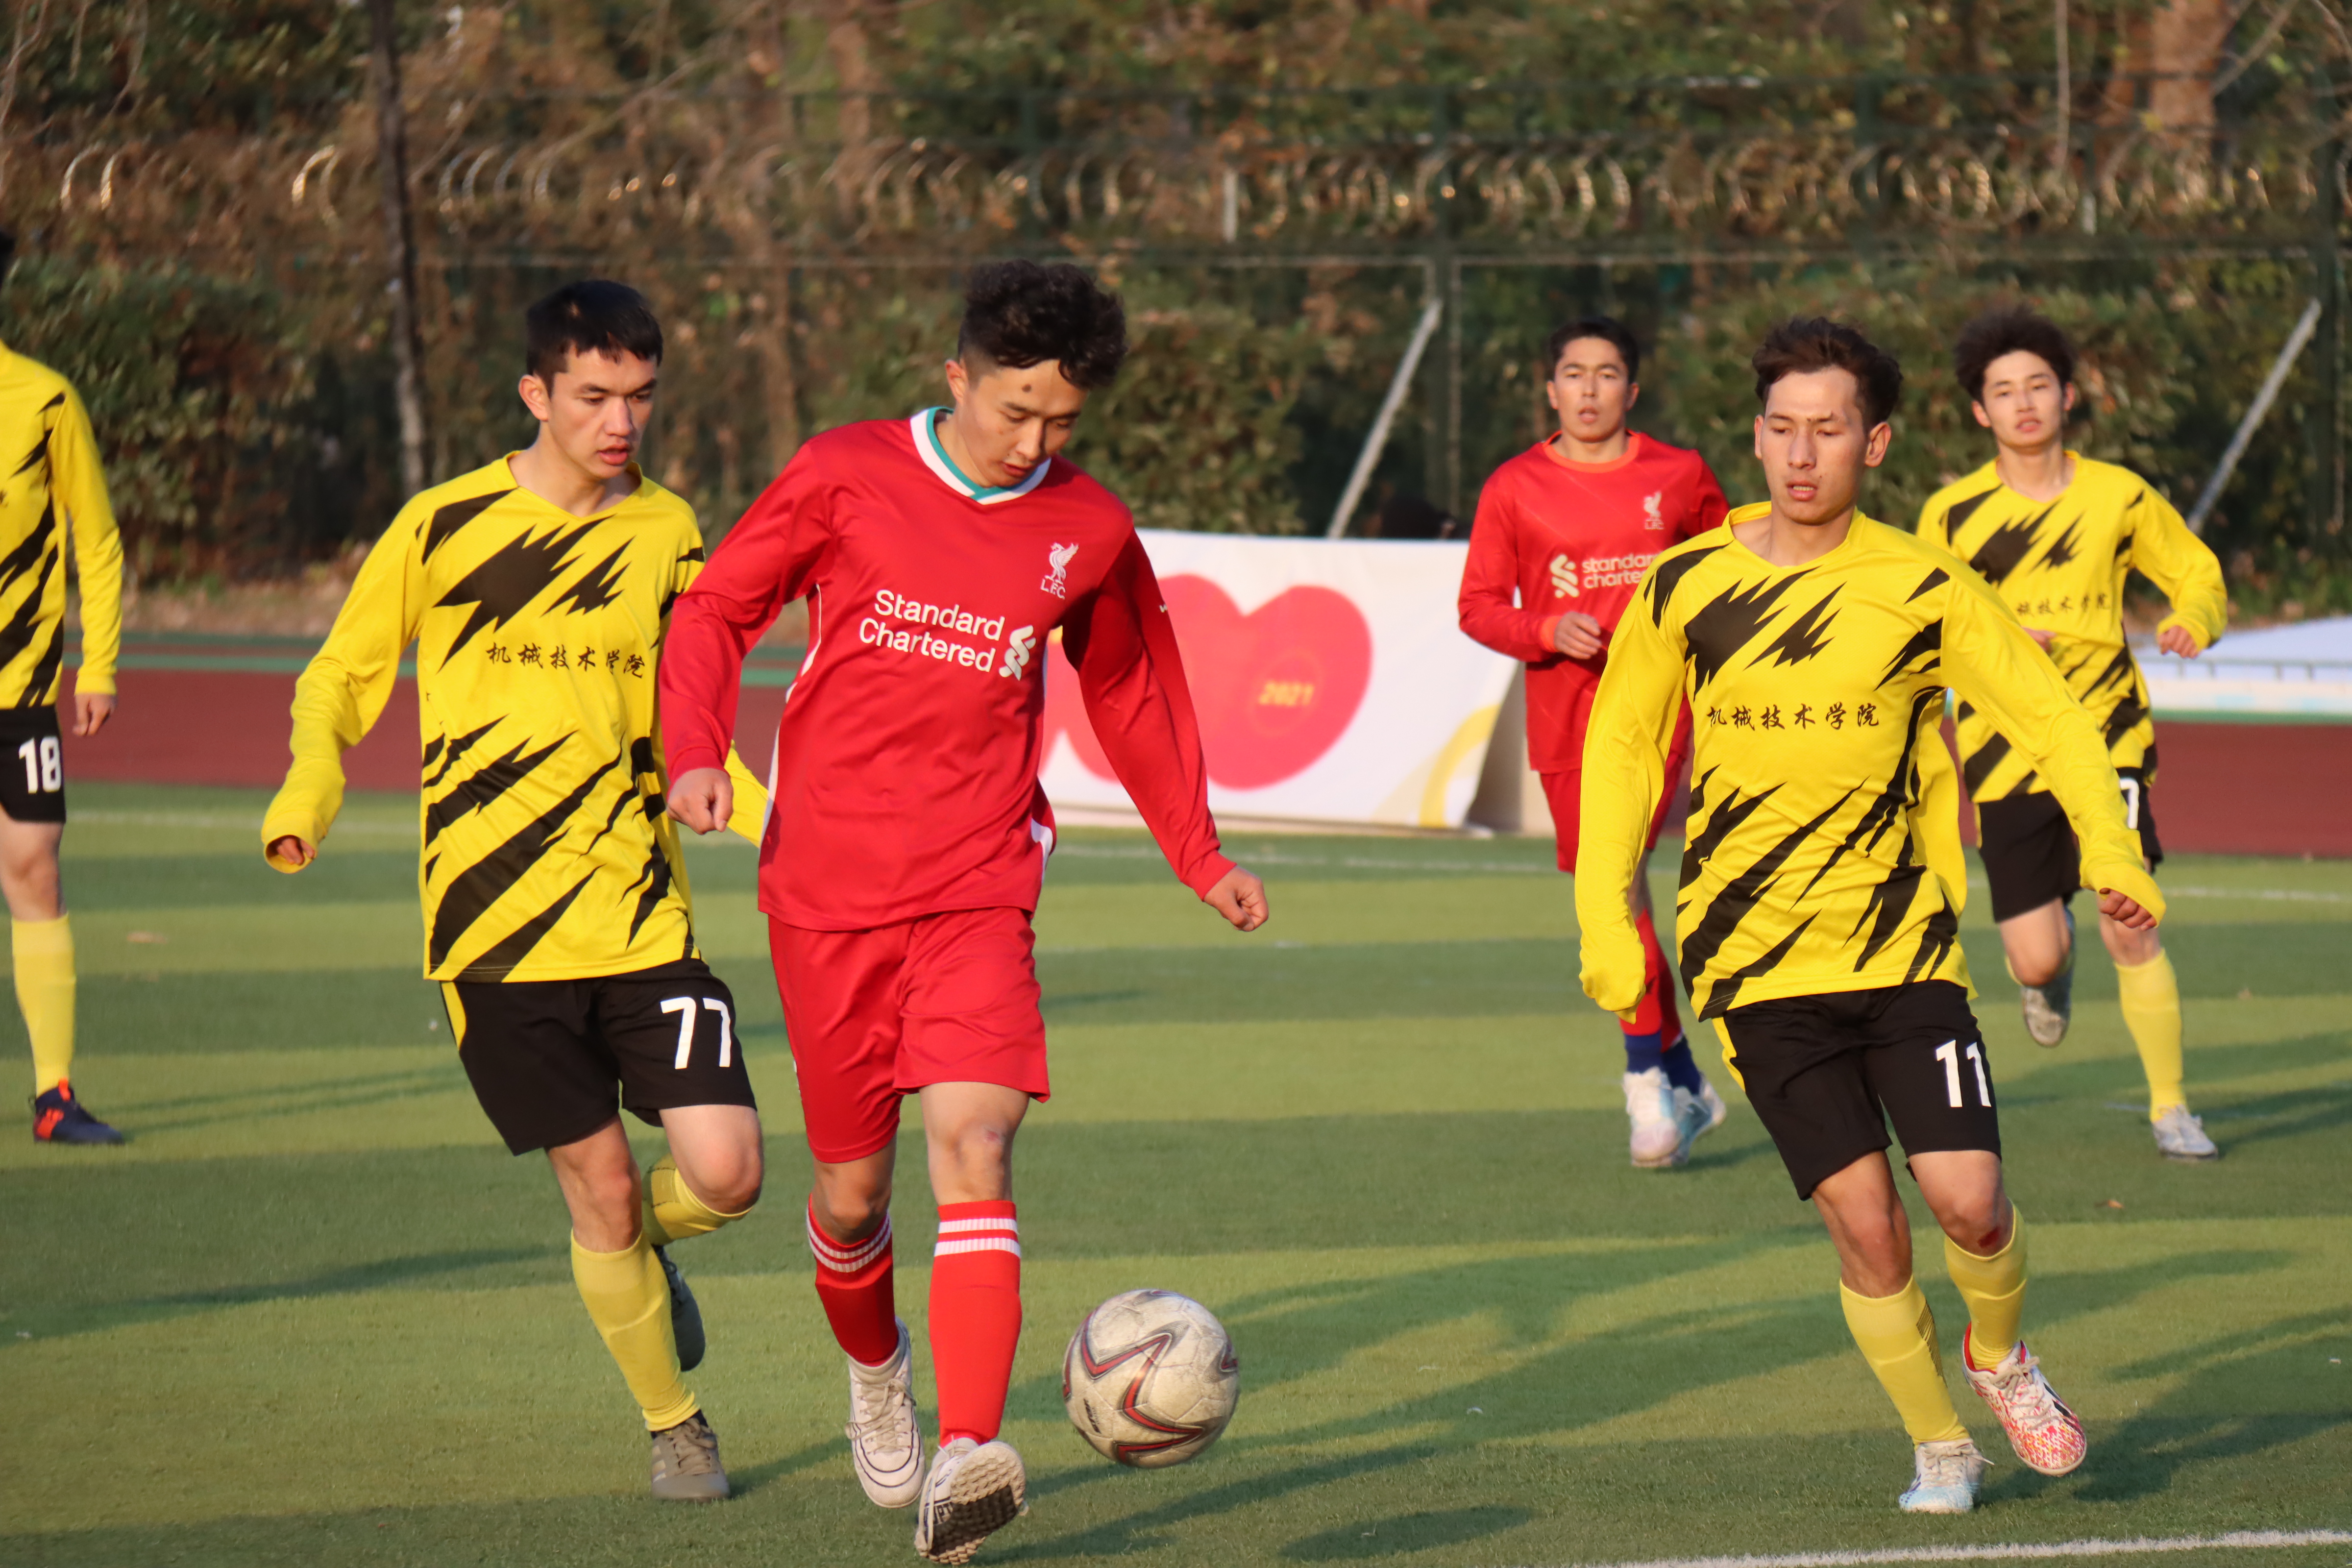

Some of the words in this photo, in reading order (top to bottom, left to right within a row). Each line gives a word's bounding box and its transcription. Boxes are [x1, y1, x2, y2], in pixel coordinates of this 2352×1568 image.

[1582, 552, 1663, 573] standar
[1584, 569, 1646, 589] charte
[1040, 578, 1066, 600] LFC
[874, 589, 1006, 641] Standard
[486, 641, 646, 679] 机械技术学院
[858, 617, 997, 673] Chartered
[1257, 681, 1315, 707] 2021
[1707, 701, 1880, 731] 机械技术学院
[18, 735, 62, 794] 18
[660, 996, 732, 1070] 77
[1936, 1039, 1992, 1107] 11
